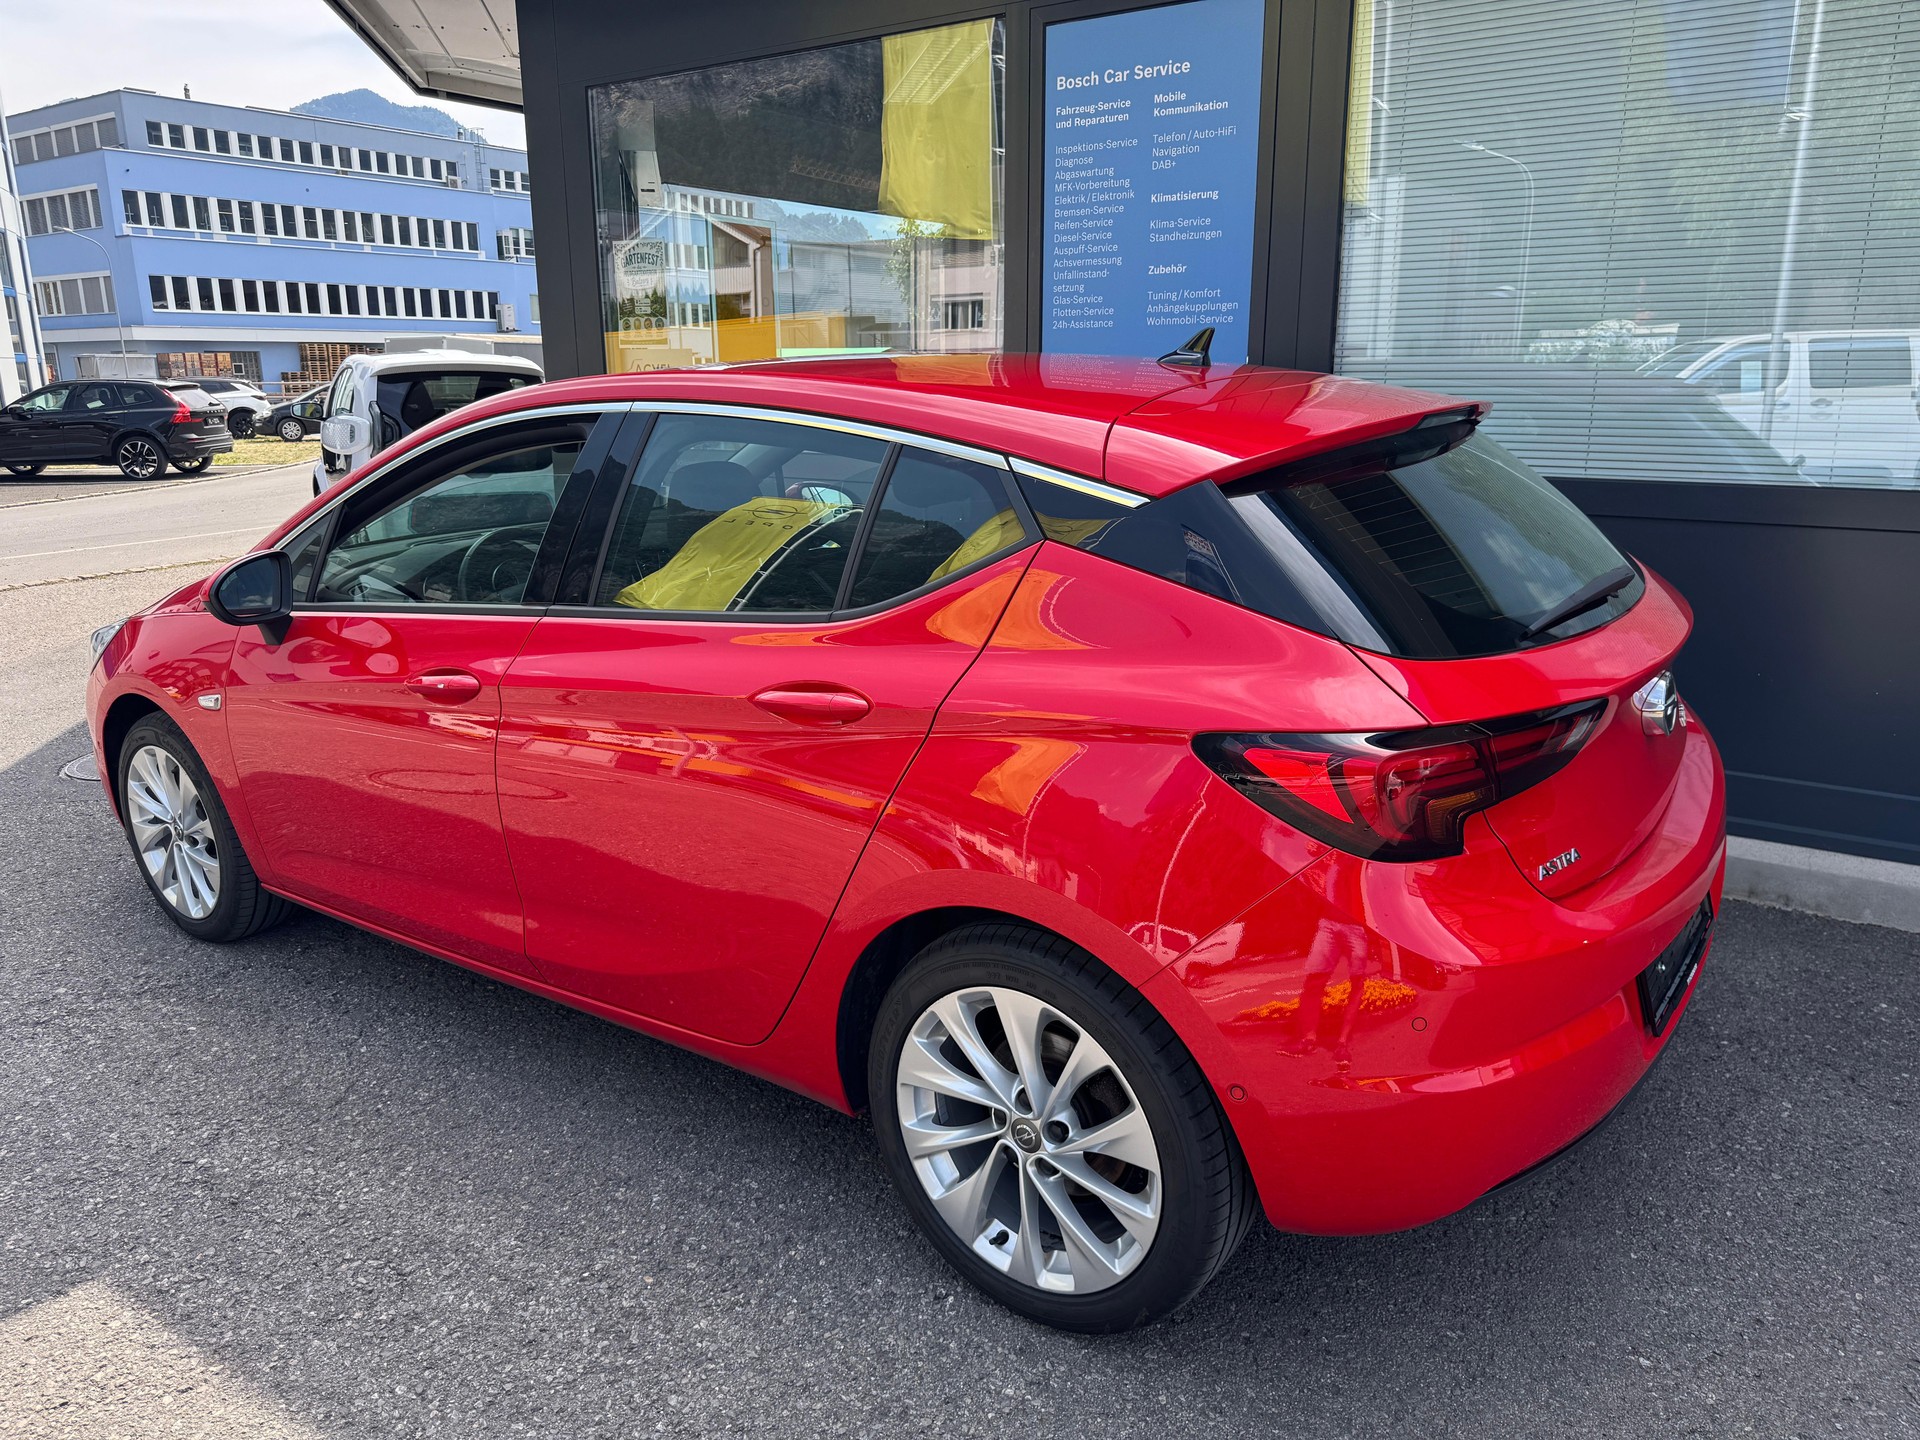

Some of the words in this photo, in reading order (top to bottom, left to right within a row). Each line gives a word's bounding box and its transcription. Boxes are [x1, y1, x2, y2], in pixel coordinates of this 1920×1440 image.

[1056, 71, 1099, 90] Bosch
[1104, 69, 1130, 84] Car
[1134, 60, 1191, 80] Service
[1154, 91, 1187, 104] Mobile
[1056, 99, 1132, 116] Fahrzeug-Service
[1154, 100, 1229, 117] Kommunikation
[1056, 118, 1072, 129] und
[1074, 113, 1129, 127] Reparaturen
[1056, 138, 1138, 155] Inspektions-Service
[1152, 144, 1200, 158] Navigation
[1056, 156, 1094, 168] Diagnose
[1152, 160, 1177, 170] DAB+
[1055, 167, 1115, 180] Abgaswartung
[1055, 178, 1131, 193] MFK-Vorbereitung
[1151, 190, 1220, 204] Klimatisierung
[1054, 204, 1124, 218] Bremsen-Service
[1054, 218, 1114, 230] Reifen-Service
[1150, 216, 1211, 230] Klima-Service
[1054, 230, 1112, 244] Diesel-Service
[1150, 230, 1222, 243] Standheizungen
[1054, 242, 1118, 256] Auspuff-Service
[621, 252, 660, 268] GARTENFEST
[1054, 256, 1122, 268] Achsvermessung
[1054, 268, 1110, 280] Unfallinstand-
[1148, 264, 1188, 275] Zubehör
[1053, 284, 1085, 294] setzung
[1052, 294, 1104, 305] Glas-Service
[1052, 306, 1115, 318] Flotten-Service
[1146, 302, 1239, 314] Anhängekupplungen
[1052, 320, 1114, 330] 24h-Assistance
[1146, 314, 1234, 326] Wohnmobil-Service
[1538, 848, 1582, 881] ASTRA
